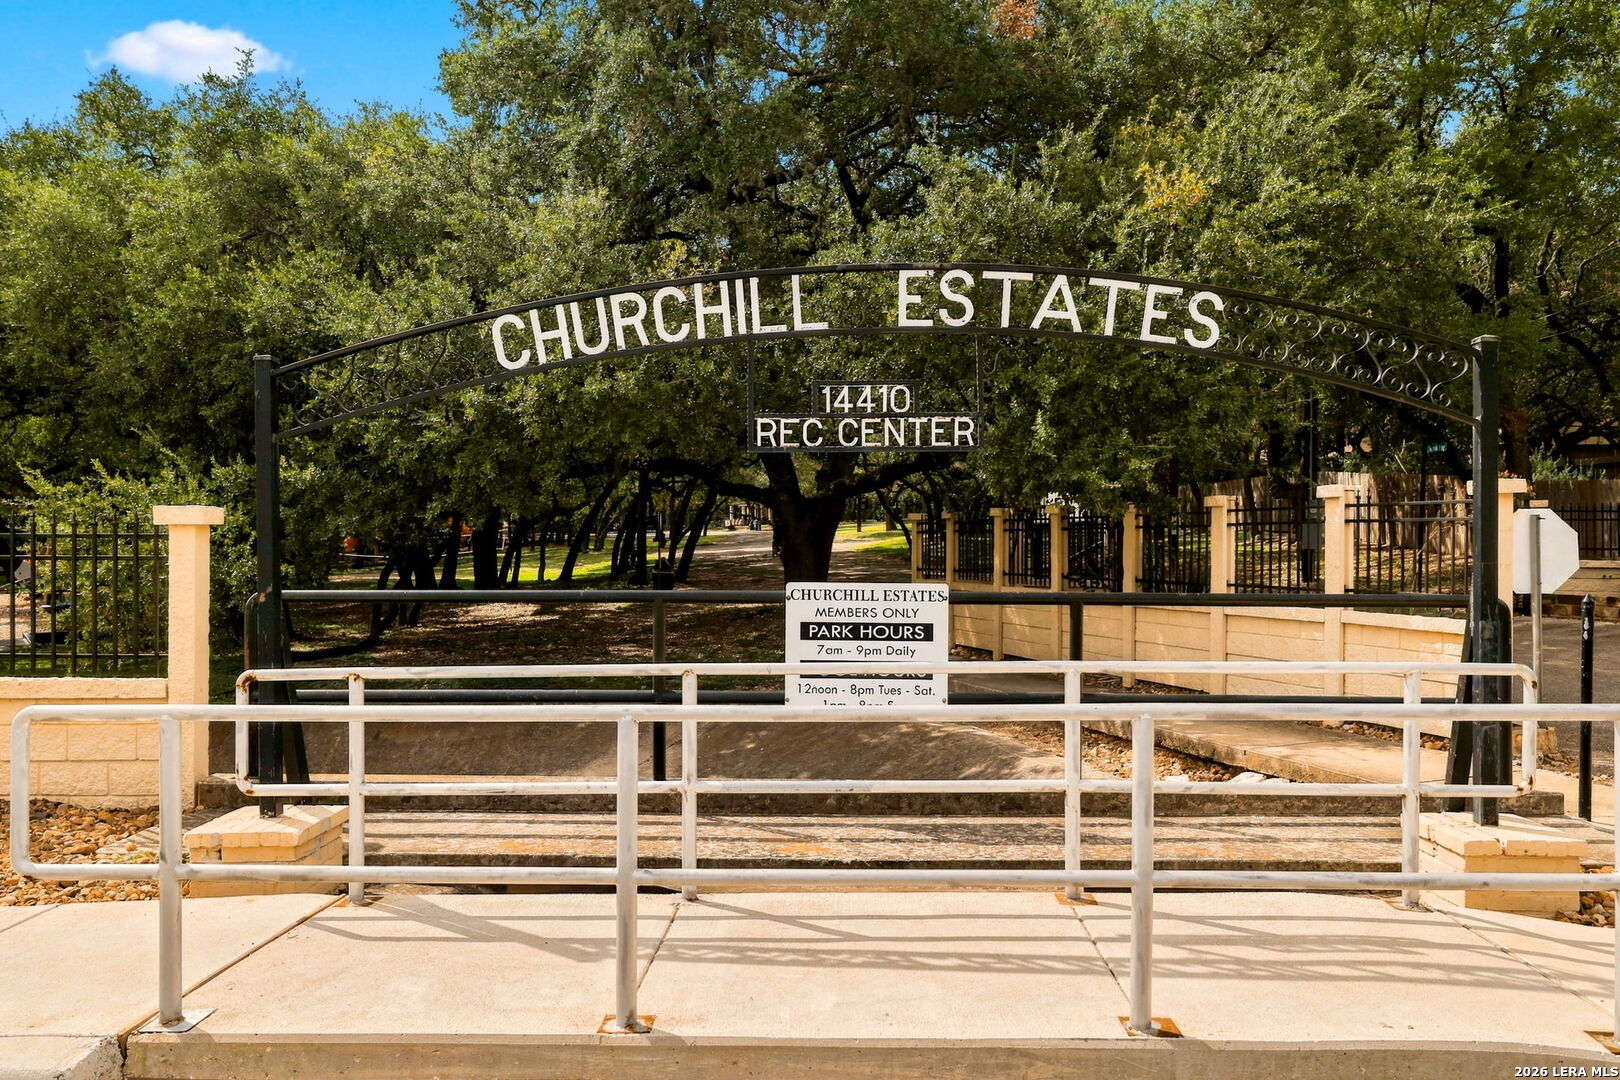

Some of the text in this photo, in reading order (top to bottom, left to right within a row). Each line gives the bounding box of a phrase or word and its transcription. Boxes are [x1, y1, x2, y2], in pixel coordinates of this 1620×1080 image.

[491, 269, 1225, 370] CHURCHILL ESTATES
[821, 384, 911, 413] 14410
[756, 417, 975, 447] REC CENTER
[790, 588, 945, 602] CHURCHILL ESTATES
[815, 607, 919, 618] MEMBERS ONLY
[809, 624, 925, 639] PARK HOURS
[817, 644, 843, 655] 7am
[856, 645, 882, 658] 9pm
[886, 646, 916, 658] Daily
[798, 683, 838, 694] 12noon
[850, 684, 874, 697] 8pm
[878, 685, 901, 695] Tues
[914, 685, 935, 696] Sat.
